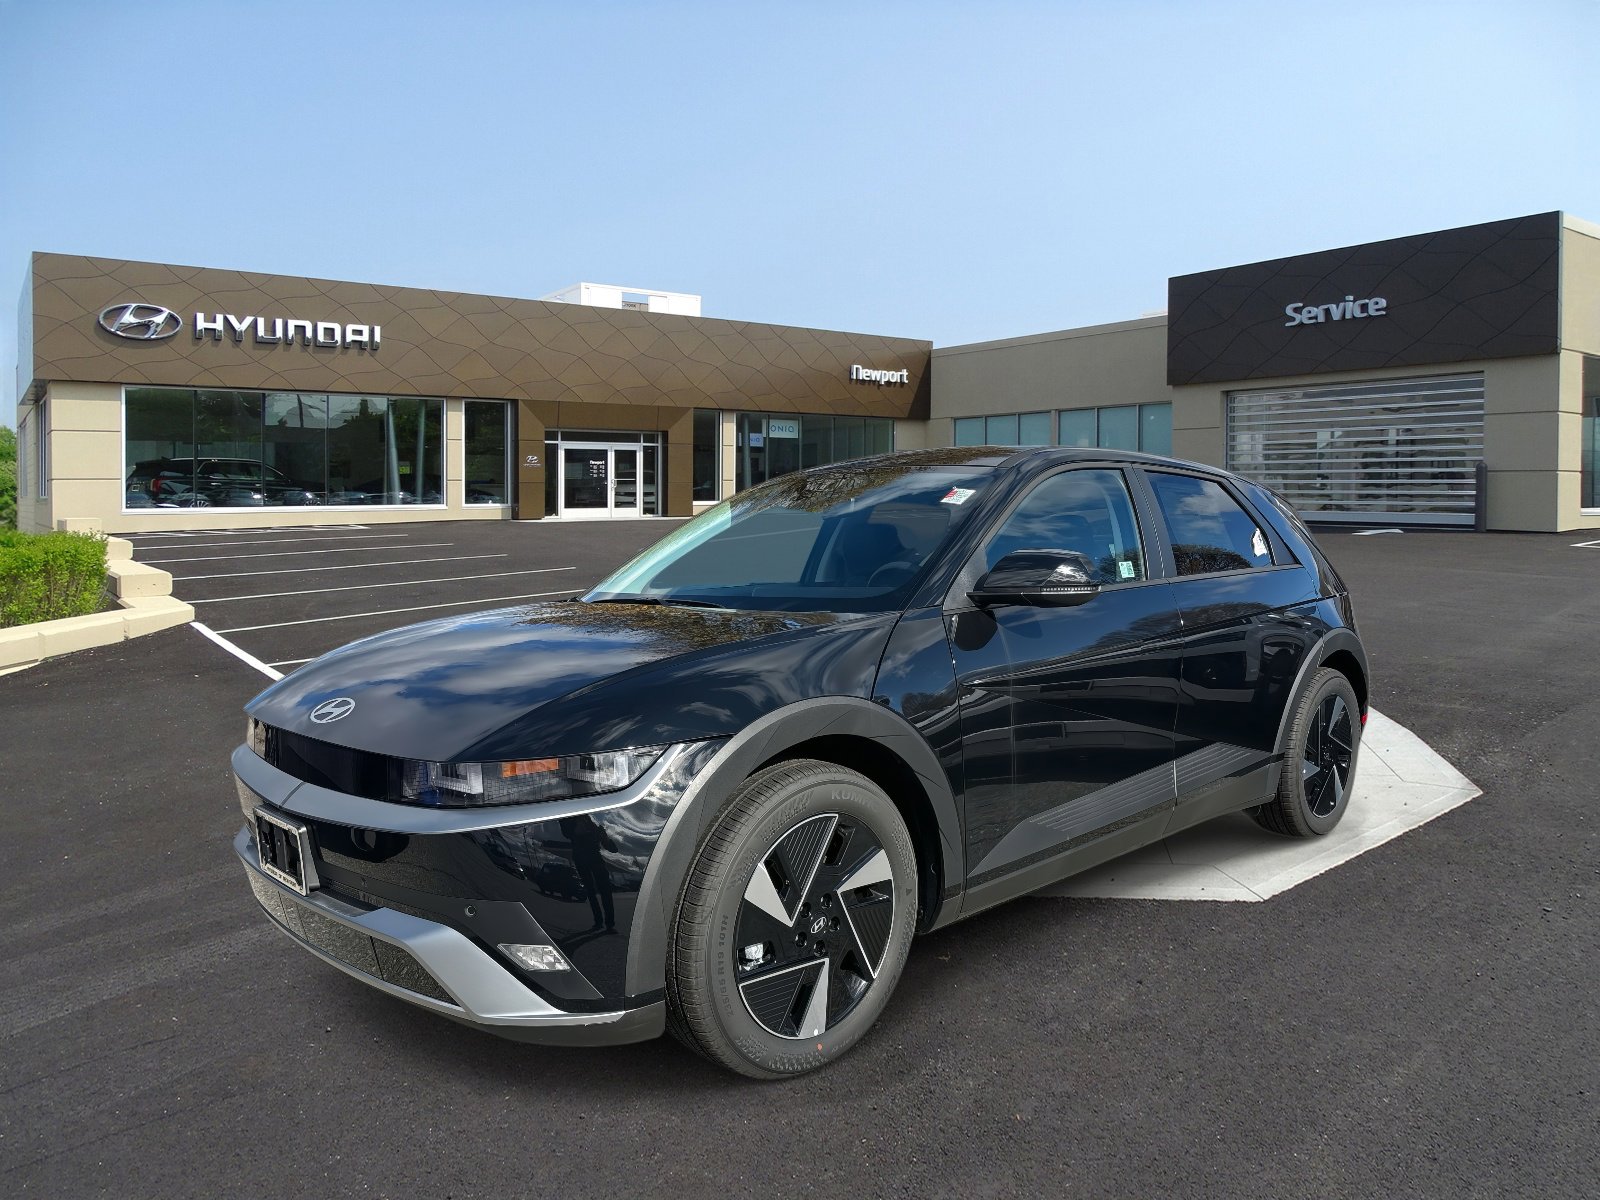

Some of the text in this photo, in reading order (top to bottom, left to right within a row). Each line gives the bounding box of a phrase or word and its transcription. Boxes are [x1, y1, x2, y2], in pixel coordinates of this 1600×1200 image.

[1285, 295, 1387, 327] Service
[195, 312, 381, 350] HYUNDAI
[851, 364, 909, 385] Newport
[769, 424, 795, 433] ONIQ
